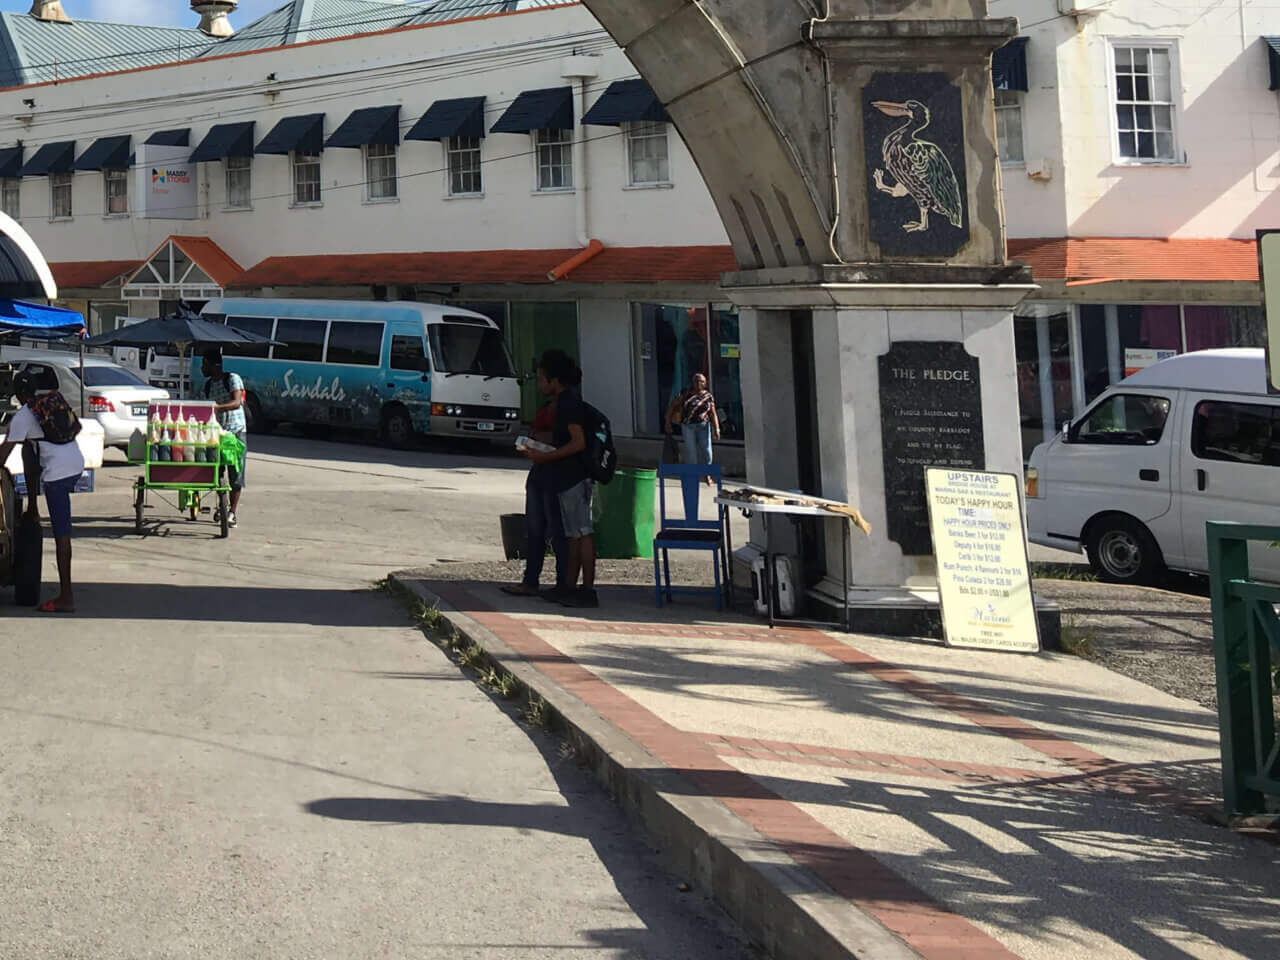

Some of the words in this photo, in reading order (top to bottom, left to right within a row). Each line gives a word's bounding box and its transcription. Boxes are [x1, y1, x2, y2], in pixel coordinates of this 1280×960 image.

[891, 368, 916, 380] THE
[923, 369, 971, 381] PLEDGE
[281, 369, 346, 401] Sandals
[947, 472, 999, 484] UPSTAIRS
[935, 495, 966, 506] TODAY'S
[967, 498, 990, 508] HAPPY
[992, 500, 1014, 510] HOUR
[958, 507, 976, 517] TIME:
